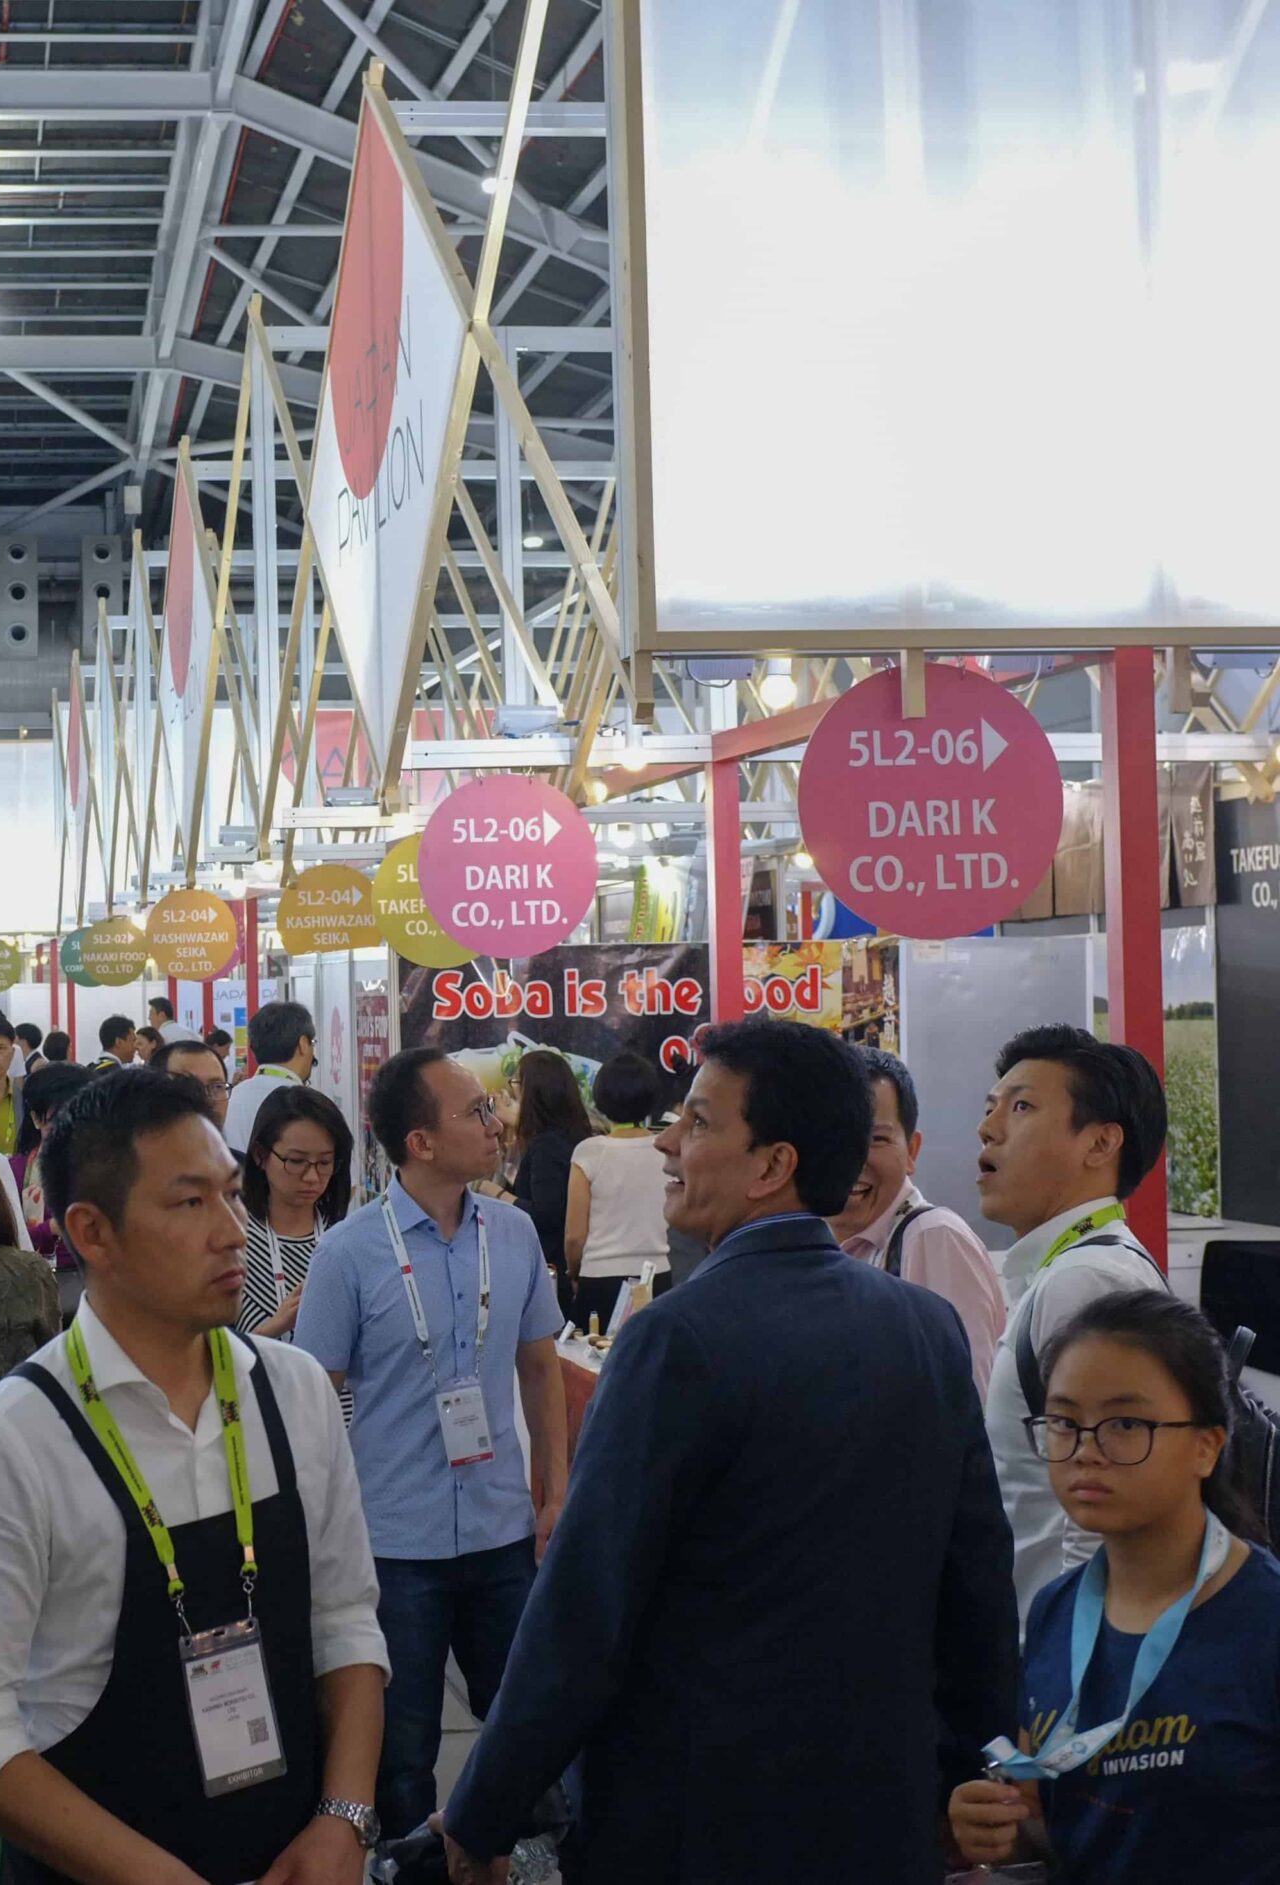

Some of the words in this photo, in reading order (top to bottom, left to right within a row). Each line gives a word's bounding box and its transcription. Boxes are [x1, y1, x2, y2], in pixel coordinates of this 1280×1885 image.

[848, 728, 979, 768] 5L2-06
[868, 800, 961, 838] DARI
[973, 799, 998, 835] K
[452, 816, 542, 845] 5L2-06
[465, 864, 529, 891] DARI
[536, 863, 553, 889] K
[848, 856, 926, 898] CO.,
[935, 852, 1020, 890] LTD.
[297, 890, 351, 906] 5L2-04
[377, 898, 427, 915] TAKEF
[162, 910, 208, 924] 5L2-04
[286, 914, 376, 929] KASHIWAZAKI
[451, 902, 504, 930] CO.,
[510, 899, 569, 926] LTD.
[92, 933, 128, 945] 5L2-02
[152, 932, 229, 945] KASHIWAZAKI
[313, 932, 350, 945] SEIKA
[120, 952, 146, 962] FOOD
[176, 947, 207, 958] SEIKA
[191, 961, 217, 972] LTD.
[432, 968, 554, 1021] Soba
[563, 967, 608, 1018] is
[617, 965, 704, 1017] the
[742, 963, 823, 1015] ood
[1103, 1749, 1186, 1777] INVASION
[227, 1766, 264, 1785] EXHIBITOR
